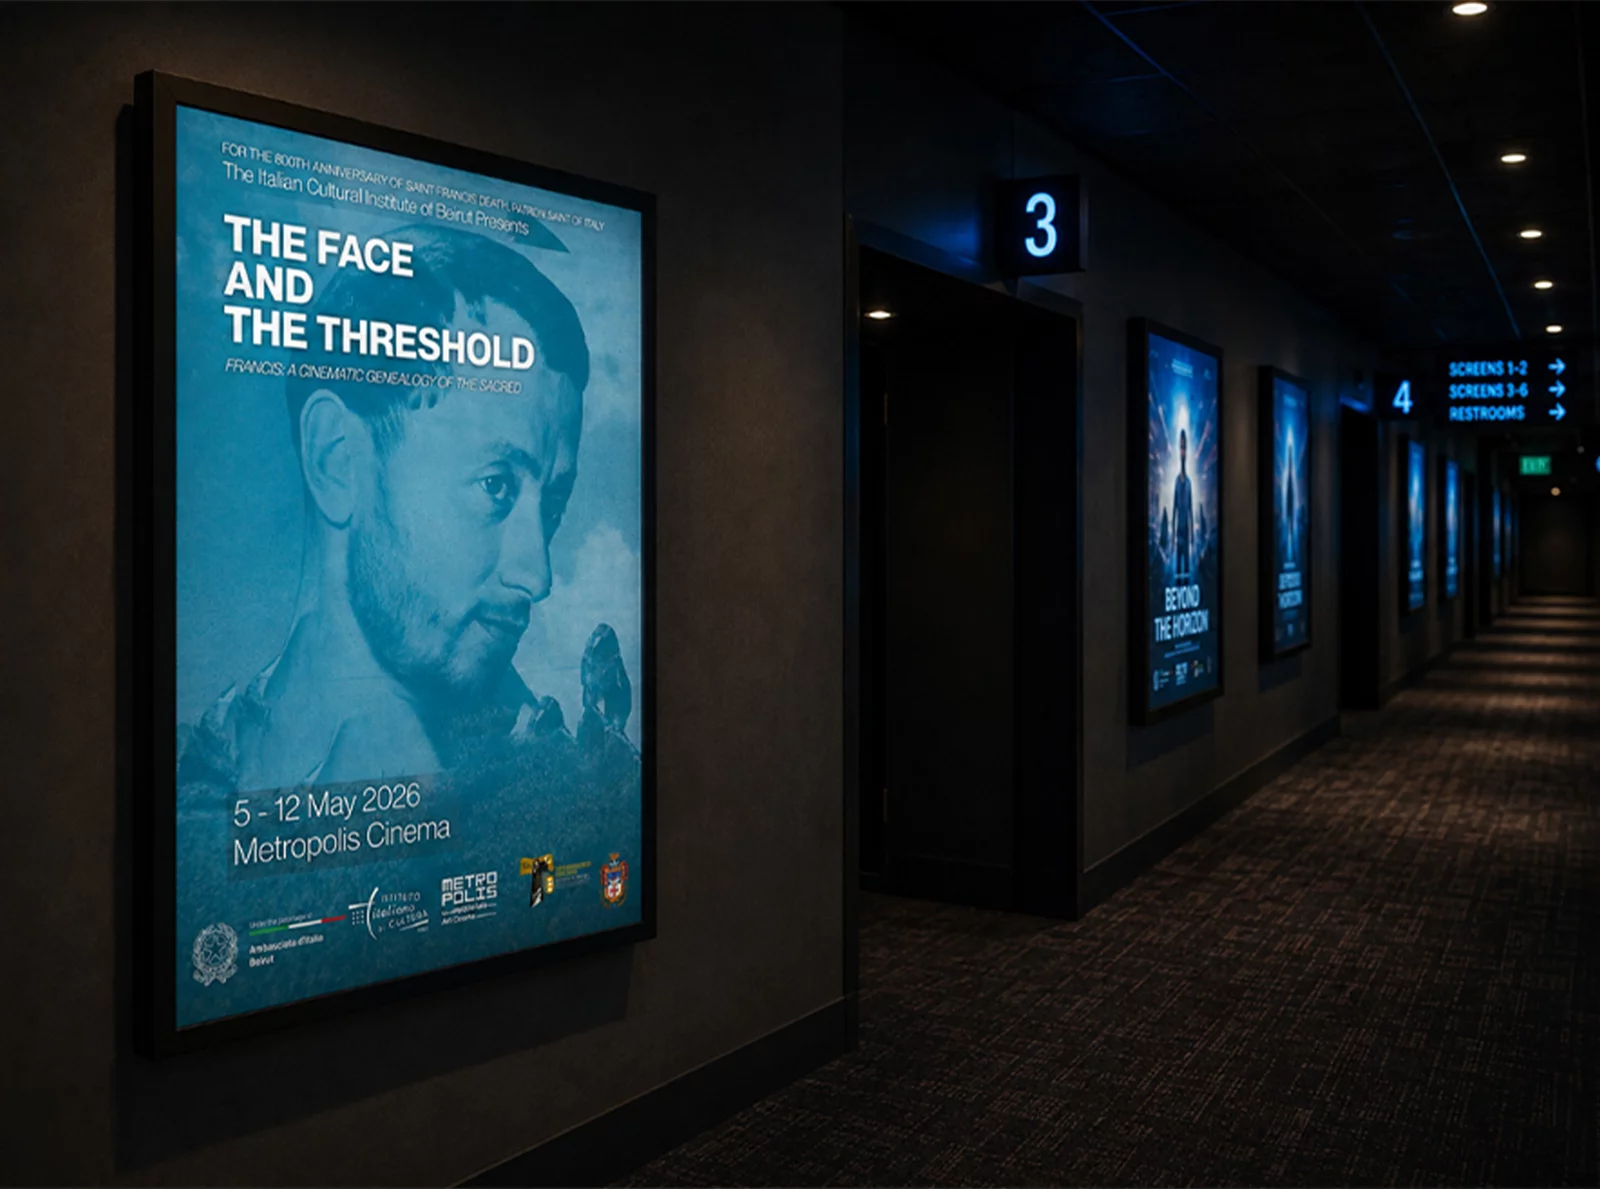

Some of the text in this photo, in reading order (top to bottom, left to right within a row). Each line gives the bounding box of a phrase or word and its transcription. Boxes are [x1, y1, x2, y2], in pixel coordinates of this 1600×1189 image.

[222, 142, 247, 158] FOR
[249, 147, 272, 164] THE
[274, 153, 310, 169] 800TH
[312, 162, 388, 184] ANNIVERSARY
[388, 177, 402, 189] OF
[405, 179, 434, 195] SAINT
[435, 186, 477, 204] FRANCIS
[222, 161, 530, 236] The Italian Cultural Institute of Beirut Presents
[1025, 192, 1058, 258] 3
[223, 214, 414, 277] THE FACE
[223, 261, 314, 305] AND
[223, 305, 535, 370] THE THRESHOLD
[225, 358, 522, 394] FRANCIS: A CINEMATIC GENEALOGY OF THE SACRED
[1449, 360, 1529, 377] SCREENS 1-2
[1393, 380, 1413, 414] 4
[1449, 382, 1529, 399] SCREENS 3-6
[1449, 404, 1526, 422] RESTROOMS
[1165, 584, 1200, 612] BEYOND
[1154, 609, 1209, 642] THE HORIZON
[233, 799, 251, 827] 5
[274, 794, 300, 822] 12
[307, 791, 357, 820] May
[362, 782, 421, 813] 2026
[233, 819, 451, 865] Metropolis Cinema
[441, 871, 498, 892] METRO
[441, 885, 498, 907] POLIS
